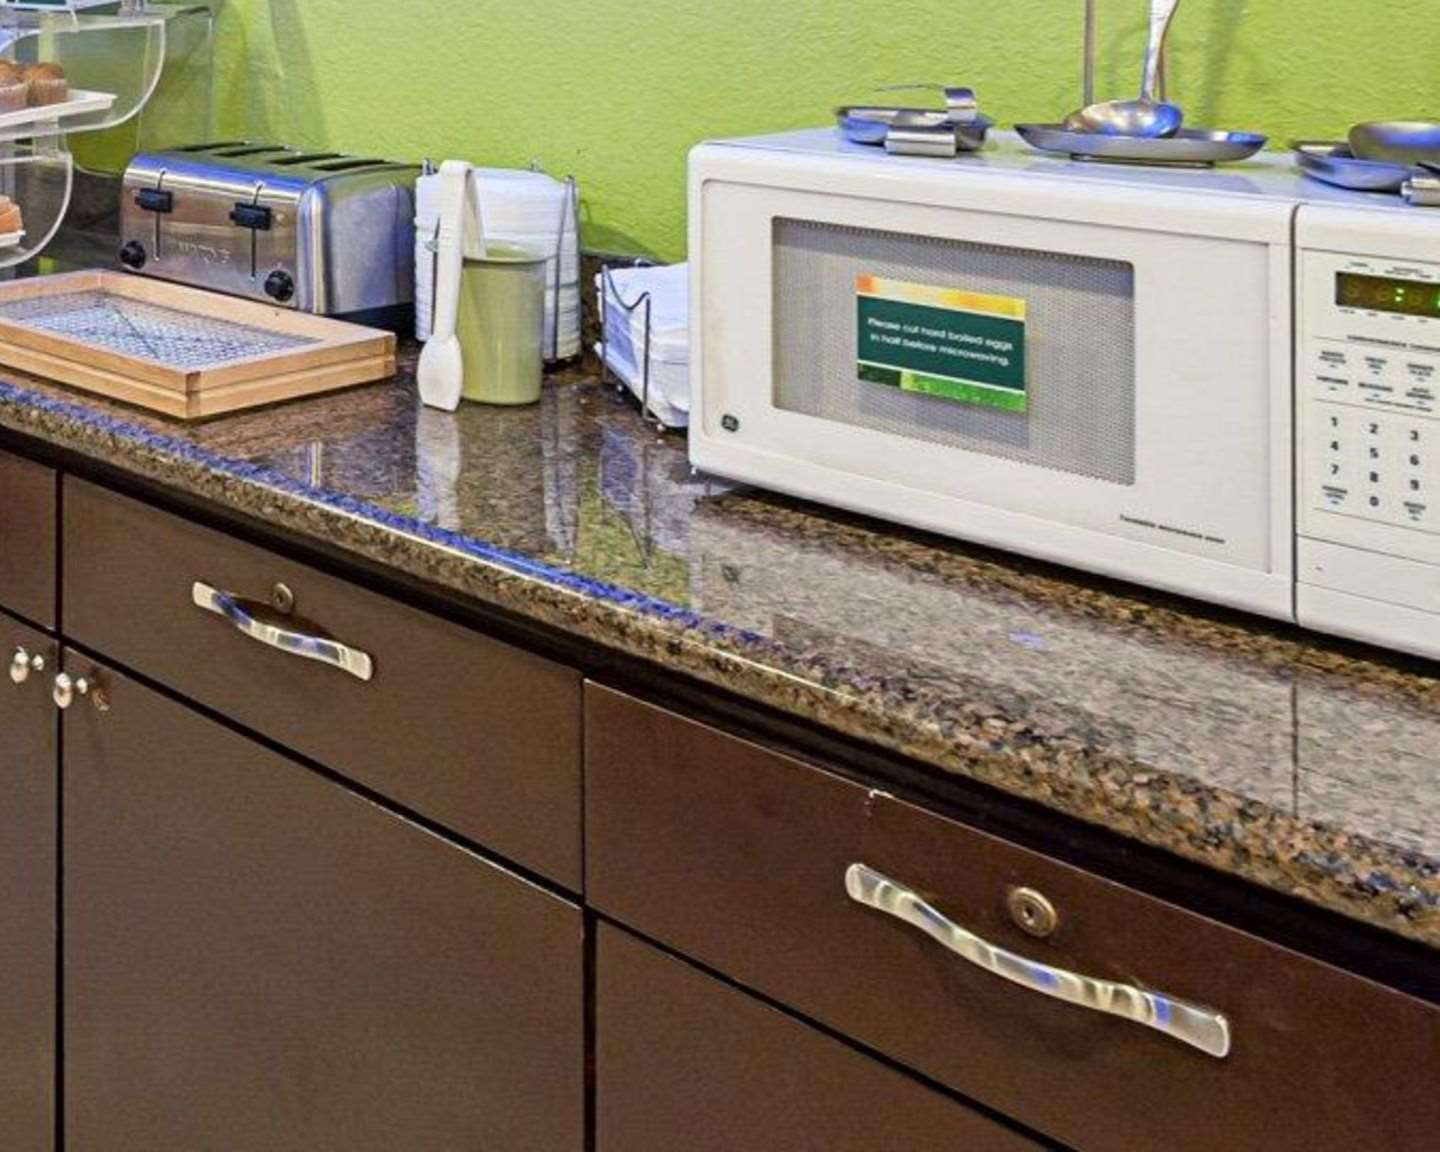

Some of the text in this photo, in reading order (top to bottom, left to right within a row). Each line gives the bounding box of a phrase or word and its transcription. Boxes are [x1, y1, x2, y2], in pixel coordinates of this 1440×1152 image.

[867, 317, 901, 332] Please
[902, 325, 920, 335] cut
[920, 327, 947, 339] hard
[948, 331, 984, 346] boiled
[870, 332, 881, 343] in
[881, 334, 902, 345] half
[902, 339, 938, 353] before
[1331, 416, 1419, 441] 1 2 3
[1330, 440, 1420, 466] 4 5 6
[1331, 463, 1420, 491] 7 8 9
[1369, 495, 1380, 507] 0
